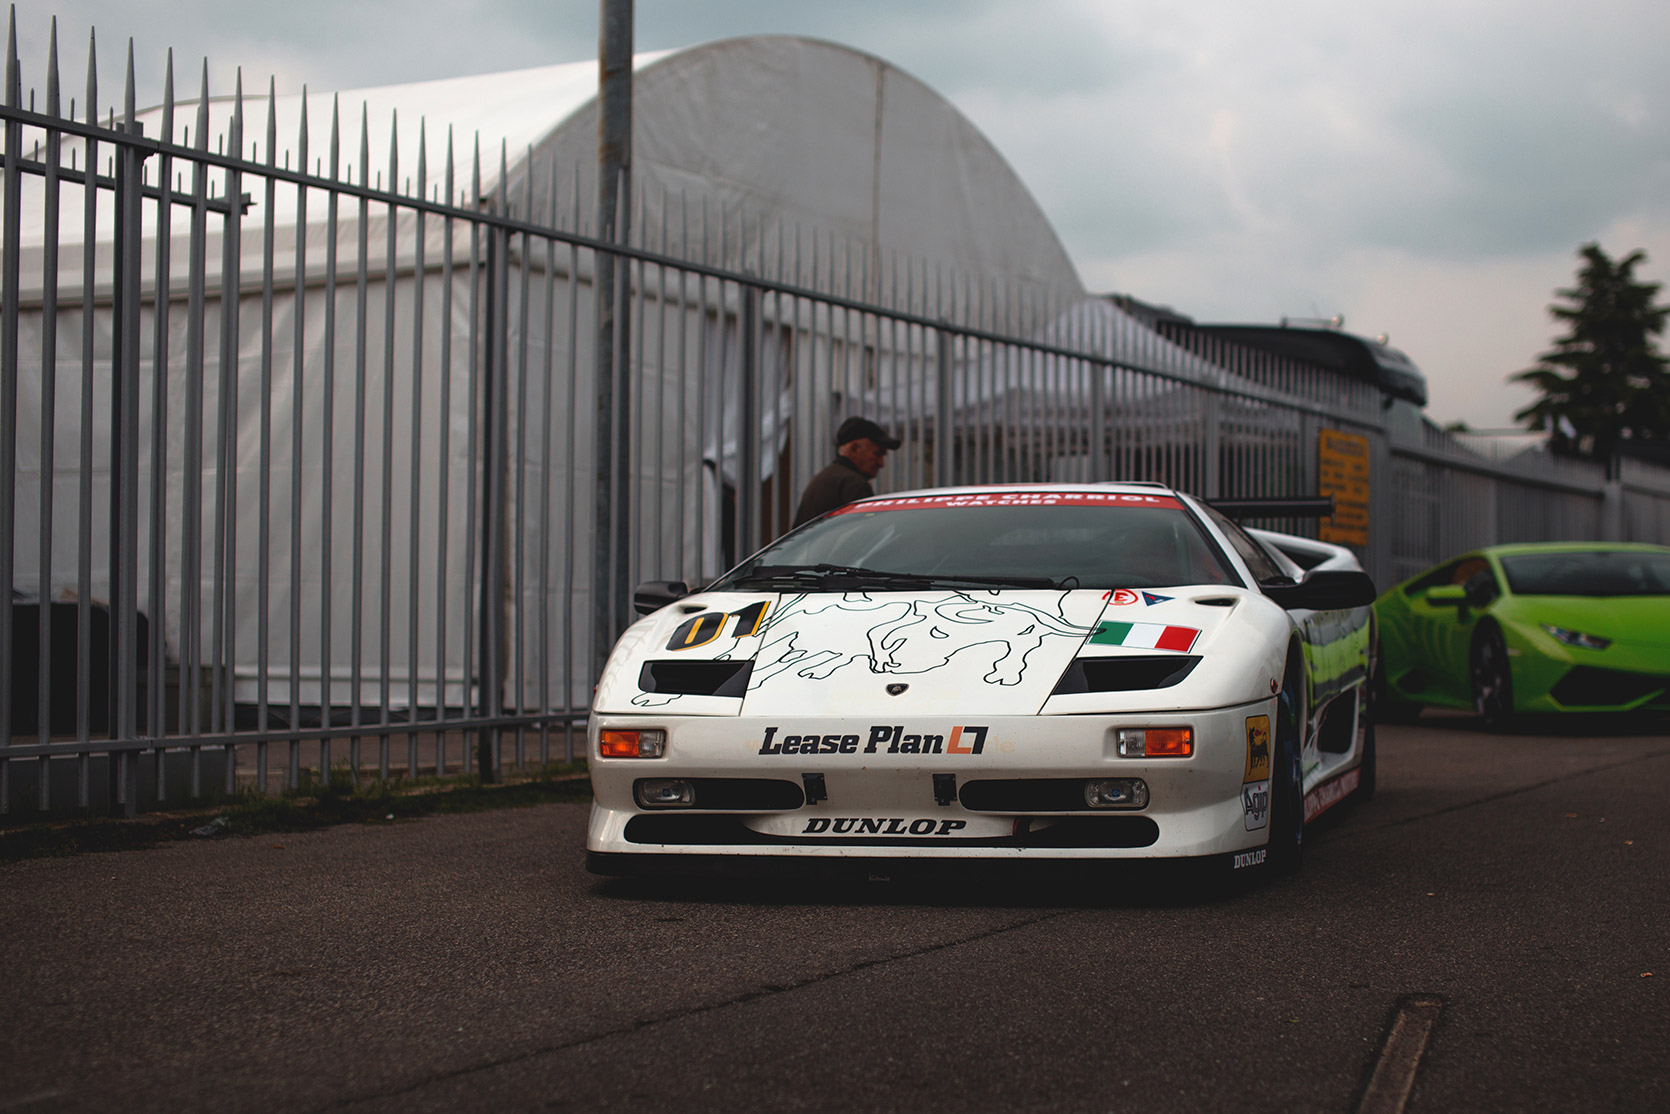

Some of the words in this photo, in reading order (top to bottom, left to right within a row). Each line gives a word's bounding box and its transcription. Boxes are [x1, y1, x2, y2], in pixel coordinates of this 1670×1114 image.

[854, 495, 991, 509] PHILIPPE
[1001, 494, 1160, 503] CHARRIOL
[758, 726, 860, 755] Lease
[863, 725, 944, 754] Plan
[1244, 785, 1268, 821] Agip
[802, 818, 967, 835] DUNLOP
[1233, 849, 1267, 869] DUNLOP
